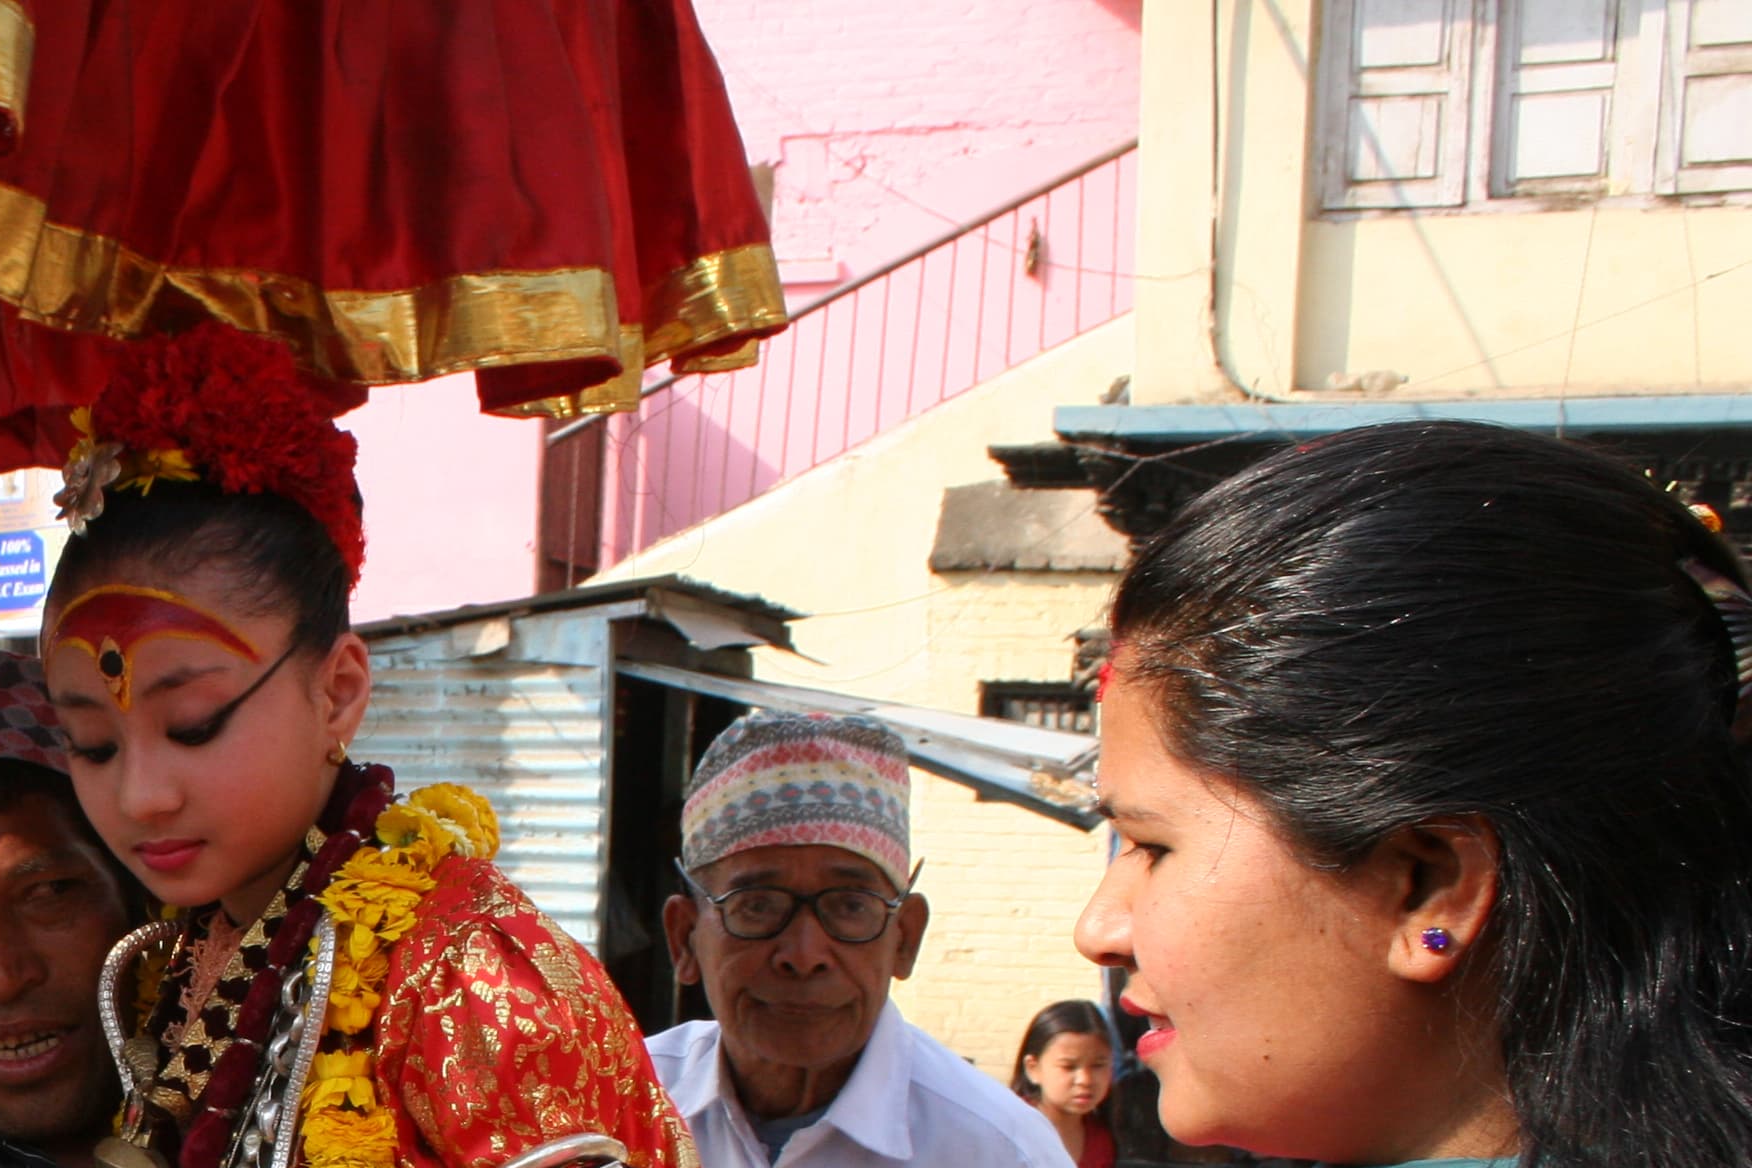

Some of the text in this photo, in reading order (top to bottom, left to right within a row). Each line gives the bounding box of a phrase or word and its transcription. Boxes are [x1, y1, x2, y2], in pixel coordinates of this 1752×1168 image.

[0, 539, 31, 556] 100%
[29, 559, 40, 573] in
[13, 581, 44, 597] Exam
